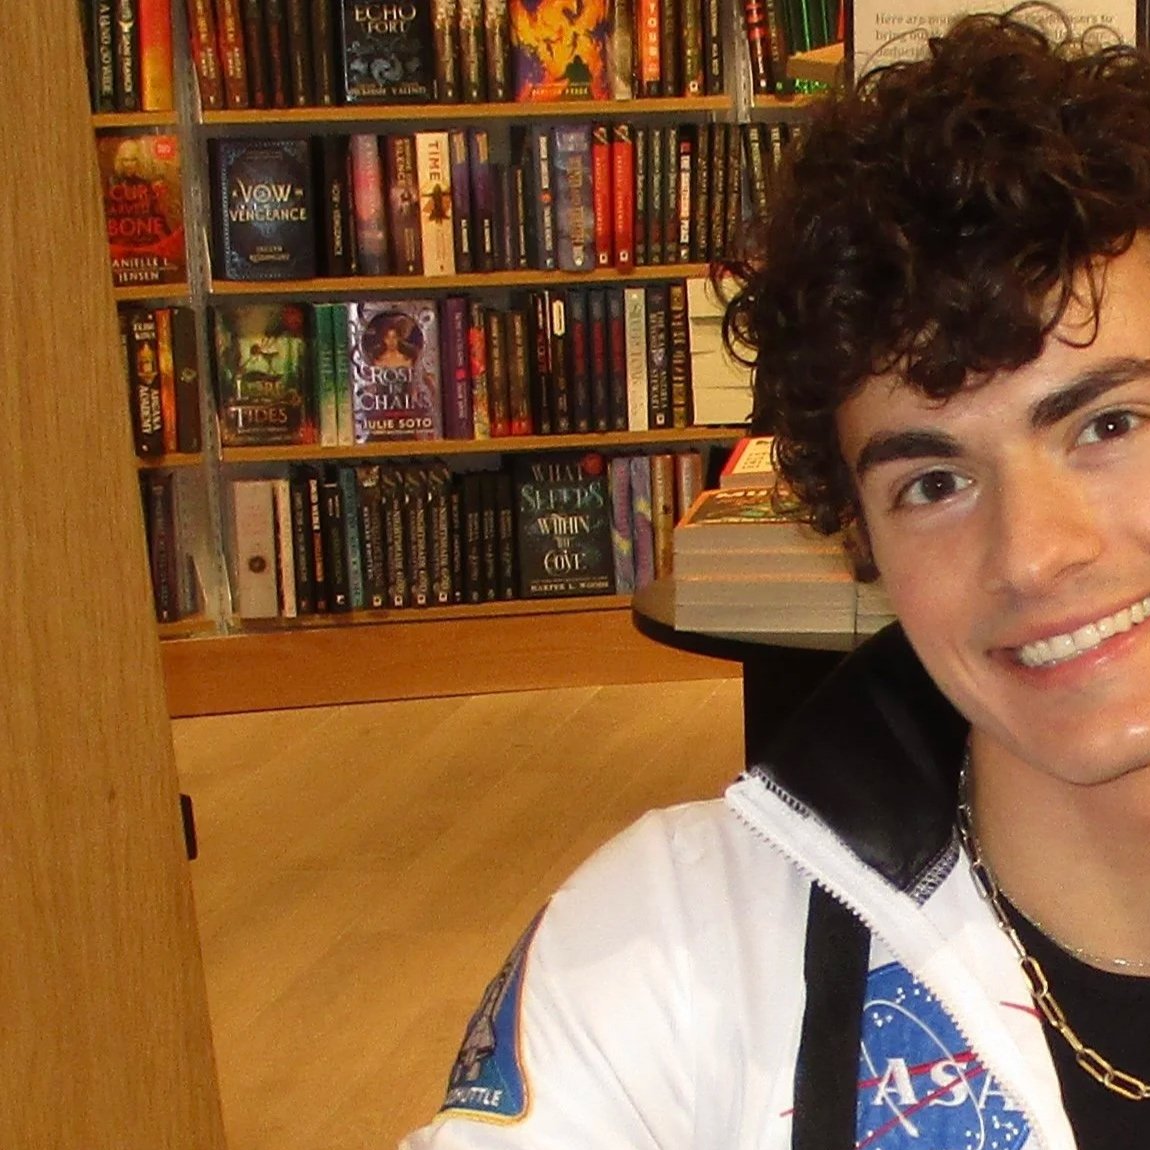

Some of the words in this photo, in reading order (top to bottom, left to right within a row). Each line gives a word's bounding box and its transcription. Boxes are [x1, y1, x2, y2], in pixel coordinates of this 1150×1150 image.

[355, 5, 417, 22] ECHO
[427, 140, 441, 181] TIME
[236, 178, 292, 203] VOW
[229, 207, 307, 222] VENGEANCE
[138, 385, 152, 434] ACADEMY
[150, 388, 162, 432] ARCANA
[358, 393, 434, 411] CHAINS
[234, 407, 288, 427] TIDES
[363, 417, 396, 430] JULIE
[398, 417, 433, 429] SOTO
[532, 463, 585, 483] WHAT
[521, 481, 605, 513] SLEEPS
[536, 512, 591, 536] WITHIN
[543, 550, 589, 575] COVE
[873, 1056, 1018, 1113] ASA
